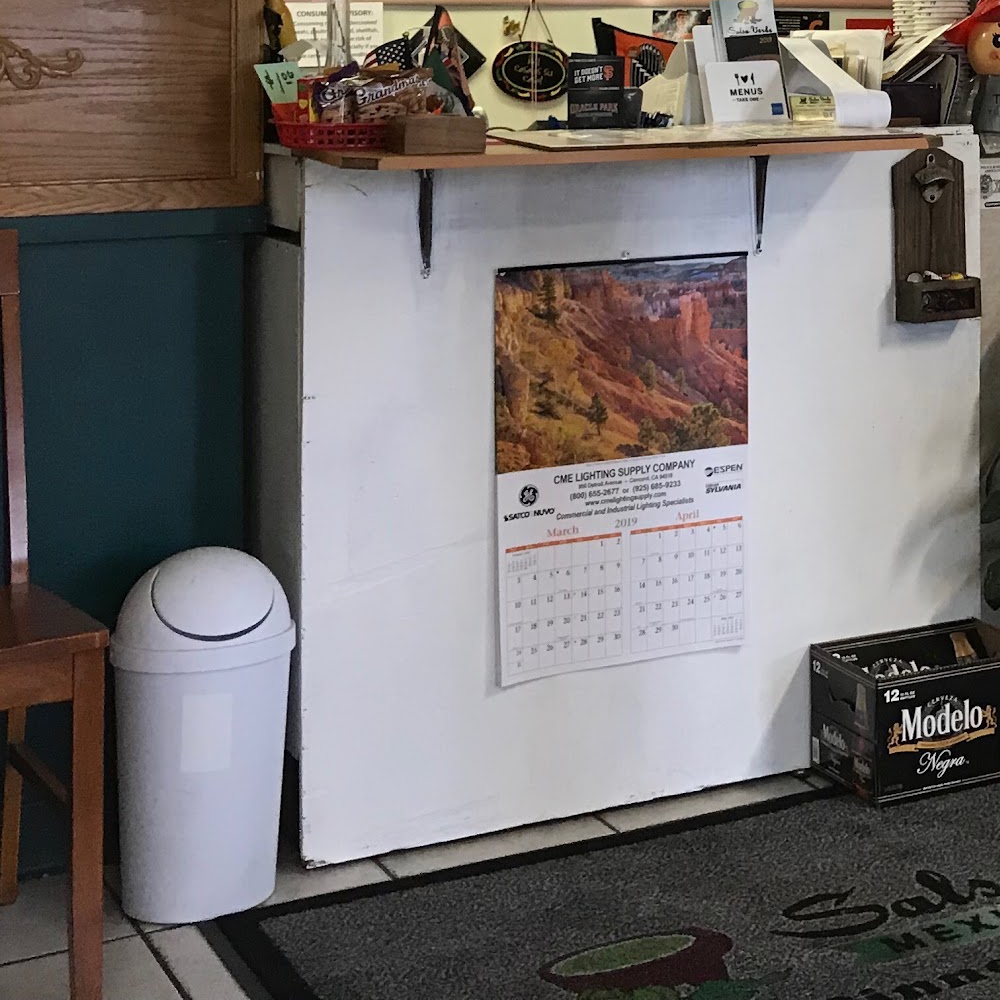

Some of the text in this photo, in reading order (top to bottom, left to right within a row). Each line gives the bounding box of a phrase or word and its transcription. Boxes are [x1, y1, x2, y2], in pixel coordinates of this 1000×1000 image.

[574, 74, 603, 84] GET MORE
[730, 88, 763, 96] MENUS
[554, 460, 695, 484] CME LIGHTING SUPPLY COMPANY
[714, 464, 742, 474] ESPEN
[706, 483, 741, 494] SYLVANIA
[556, 509, 592, 520] Commercial
[607, 504, 634, 513] Industrial
[637, 502, 660, 510] Lighting
[663, 497, 694, 506] Specialists
[615, 510, 699, 528] 2019 April
[547, 526, 579, 537] March
[884, 689, 900, 703] 12
[902, 699, 983, 742] Modelo
[916, 750, 966, 778] Negra
